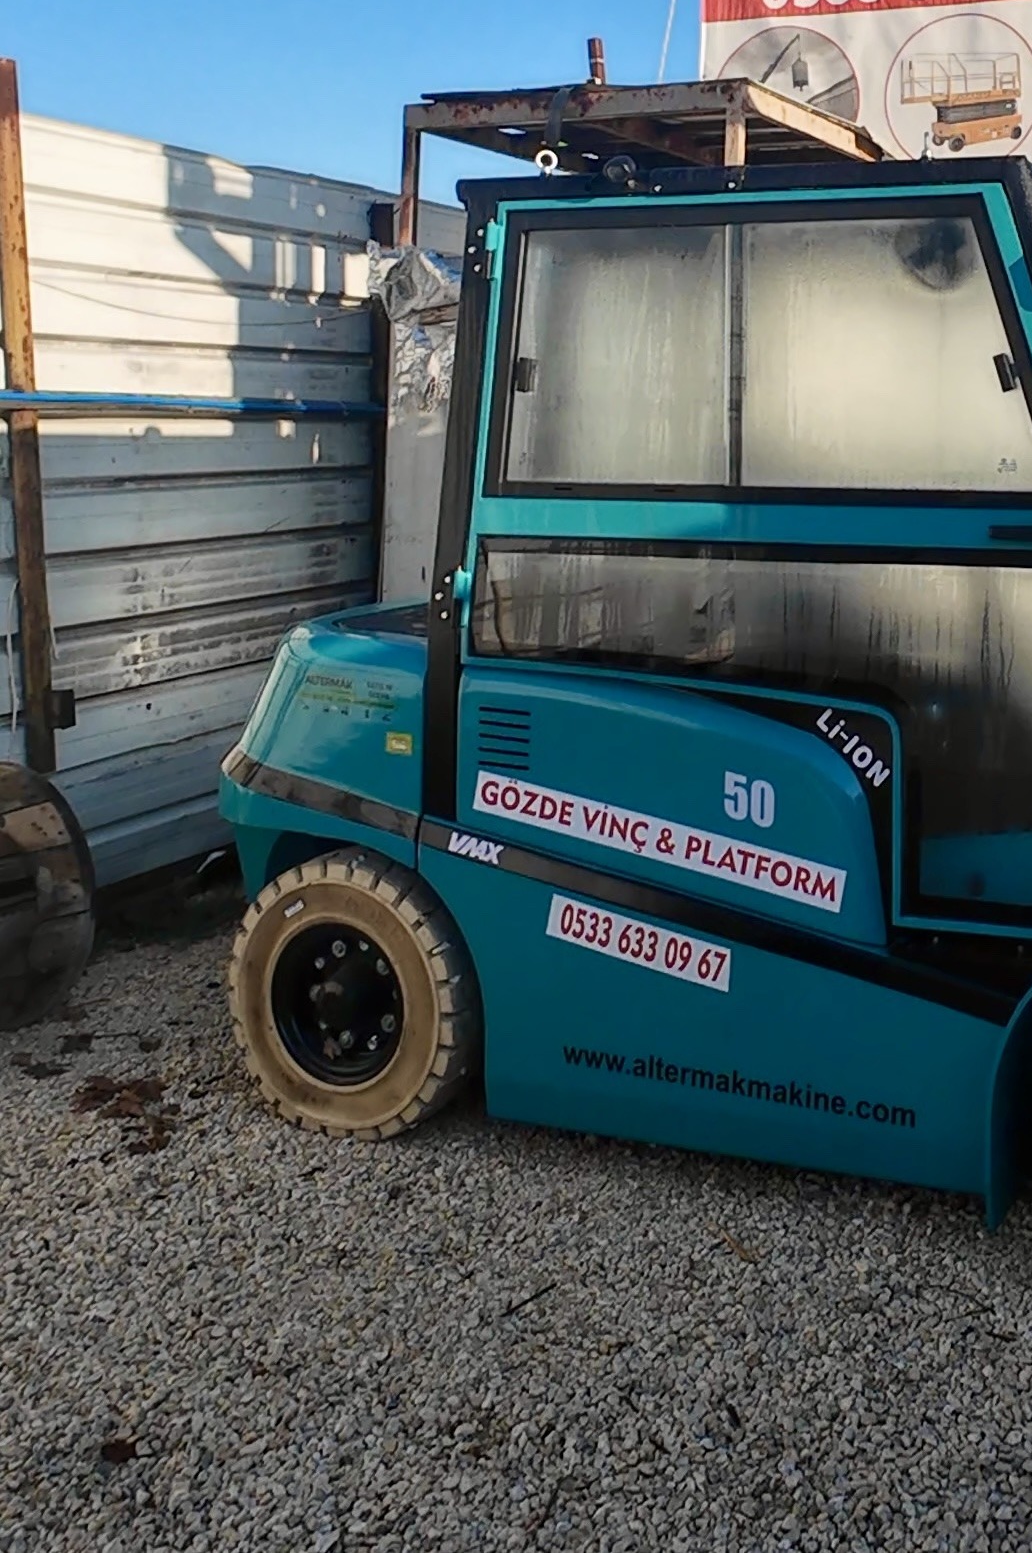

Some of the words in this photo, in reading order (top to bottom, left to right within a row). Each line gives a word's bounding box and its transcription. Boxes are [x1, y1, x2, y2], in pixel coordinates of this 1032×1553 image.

[724, 770, 775, 828] 50
[448, 832, 504, 865] VMAX
[480, 777, 575, 826] GÖZDE
[583, 804, 649, 853] VİNÇ
[656, 828, 676, 855] &
[684, 834, 836, 902] PLATFORM
[561, 904, 613, 948] 0533
[618, 924, 659, 963] 633
[664, 937, 693, 972] 09
[697, 948, 728, 982] 67
[563, 1045, 917, 1128] www.altermakmakine.com
